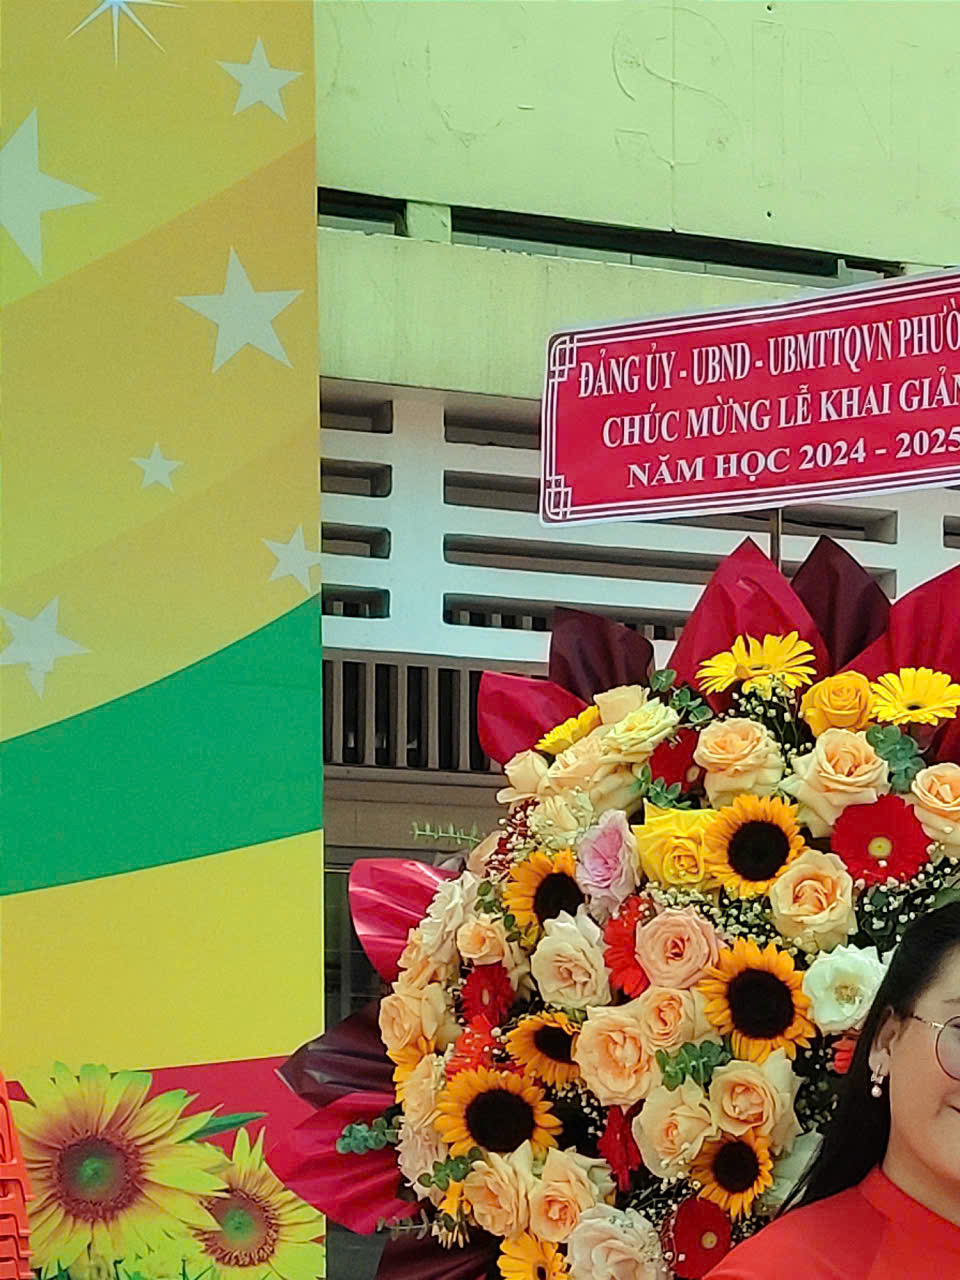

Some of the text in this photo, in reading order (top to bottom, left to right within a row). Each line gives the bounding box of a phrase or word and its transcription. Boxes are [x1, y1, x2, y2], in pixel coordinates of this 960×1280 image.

[578, 348, 640, 398] ĐẢNG
[645, 342, 676, 391] ỦY
[692, 342, 751, 386] UBND
[768, 320, 893, 376] UBMTTQVN
[602, 402, 680, 448] CHÚC
[684, 395, 772, 439] MỪNG
[777, 384, 812, 428] LỄ
[818, 383, 893, 422] KHAI
[627, 454, 704, 489] NĂM
[714, 448, 791, 482] HỌC
[798, 437, 866, 470] 2024
